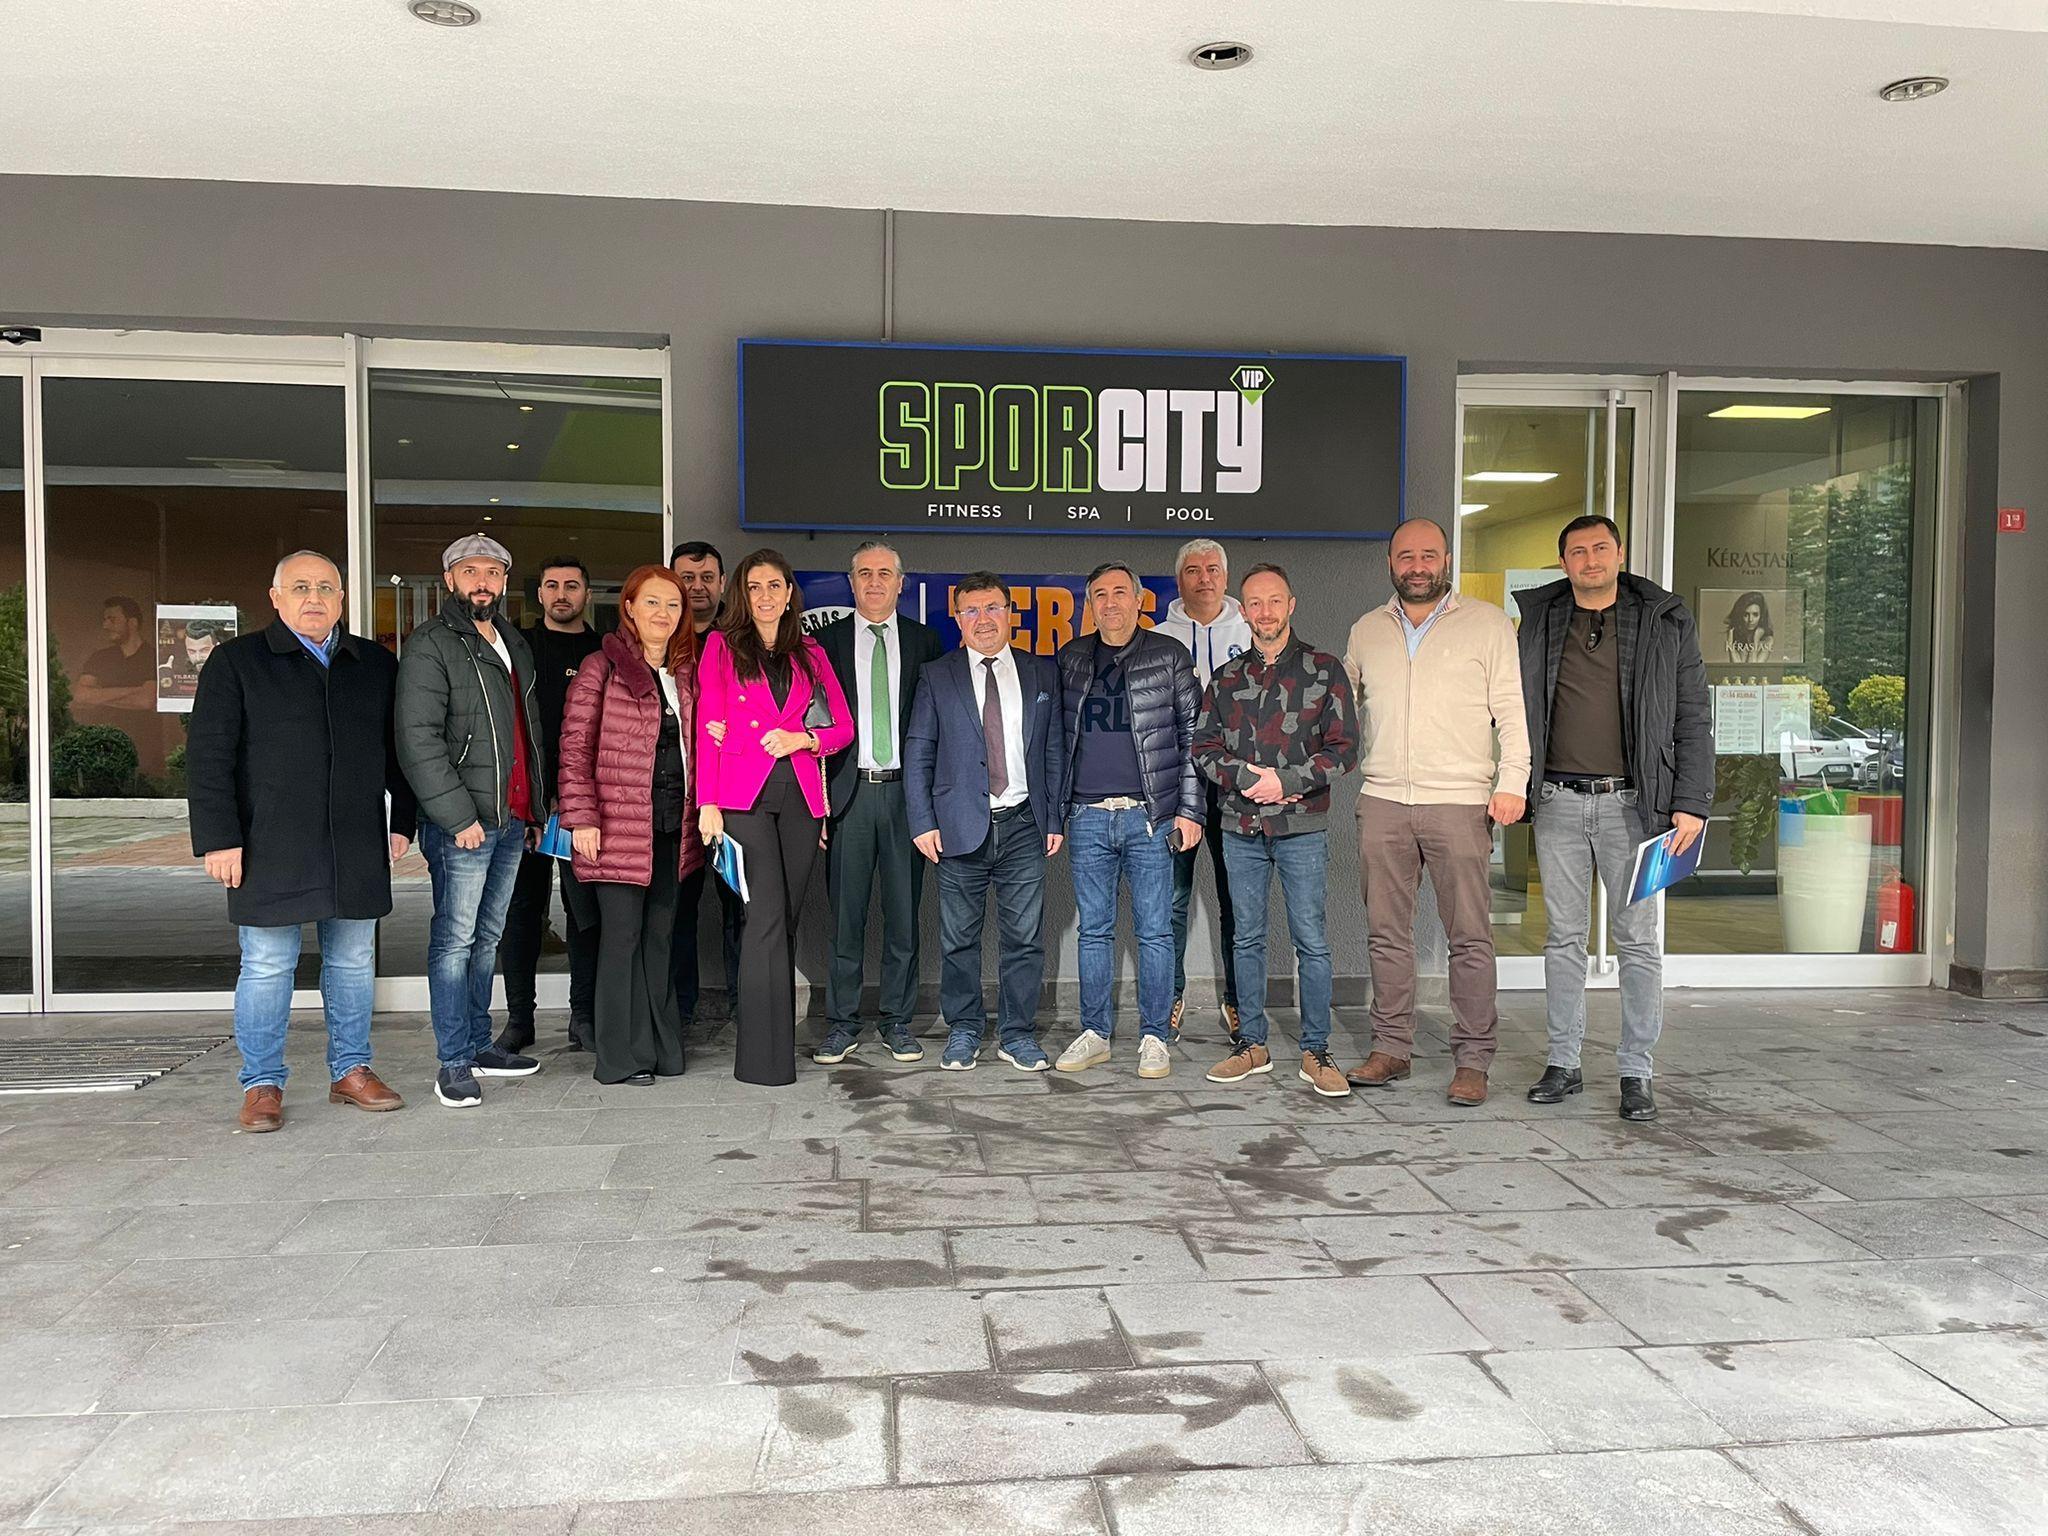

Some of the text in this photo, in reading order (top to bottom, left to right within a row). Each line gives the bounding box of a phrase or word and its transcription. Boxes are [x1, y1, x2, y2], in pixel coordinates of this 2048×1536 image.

[1241, 369, 1264, 389] VIP
[879, 380, 1263, 494] SPORCITY
[927, 503, 1214, 521] FITNESS SPA POOL
